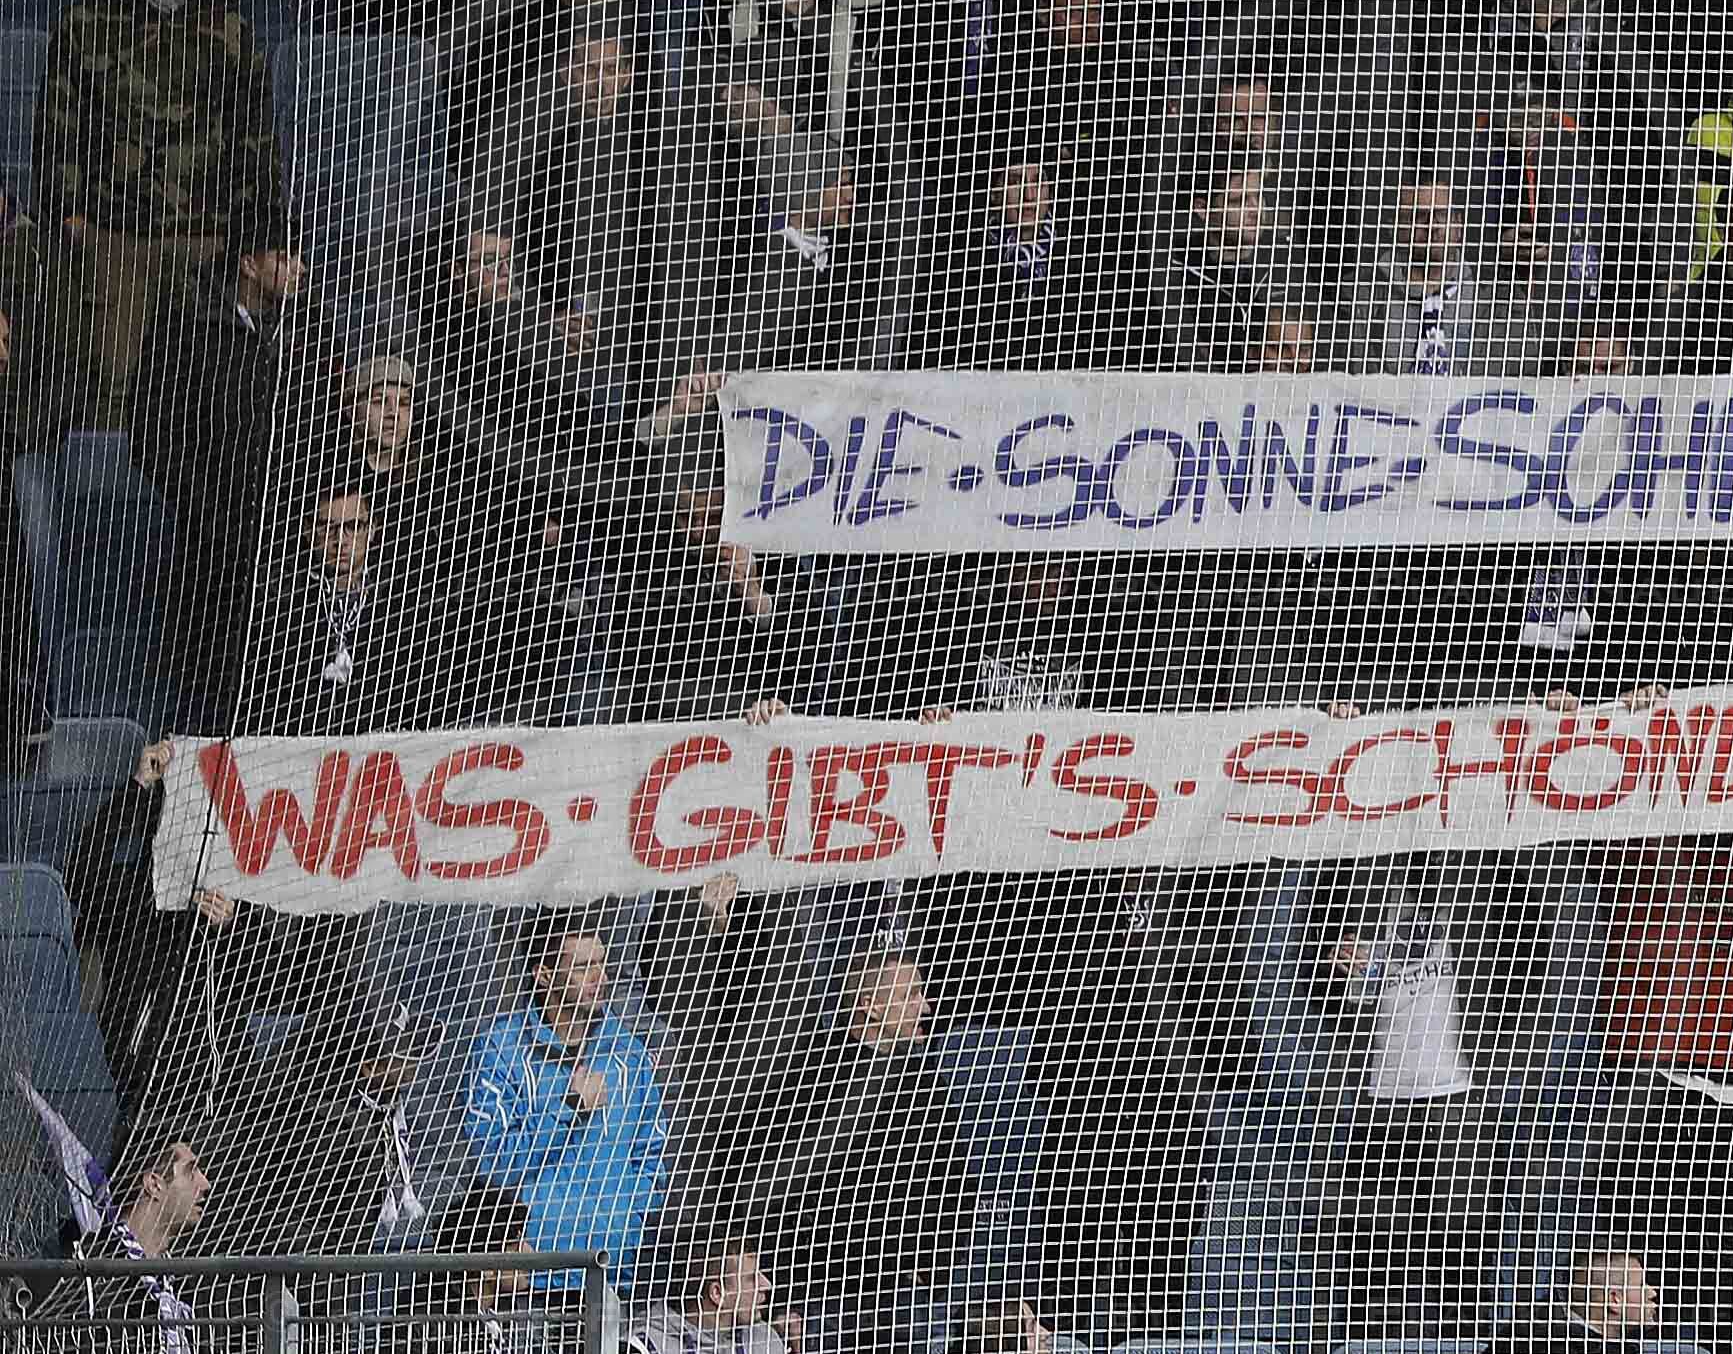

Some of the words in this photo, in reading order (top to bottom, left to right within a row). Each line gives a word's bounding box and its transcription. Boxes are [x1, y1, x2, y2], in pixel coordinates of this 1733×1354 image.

[731, 407, 962, 526] DIE
[995, 403, 1419, 528] SONNE
[199, 741, 549, 881] WAS
